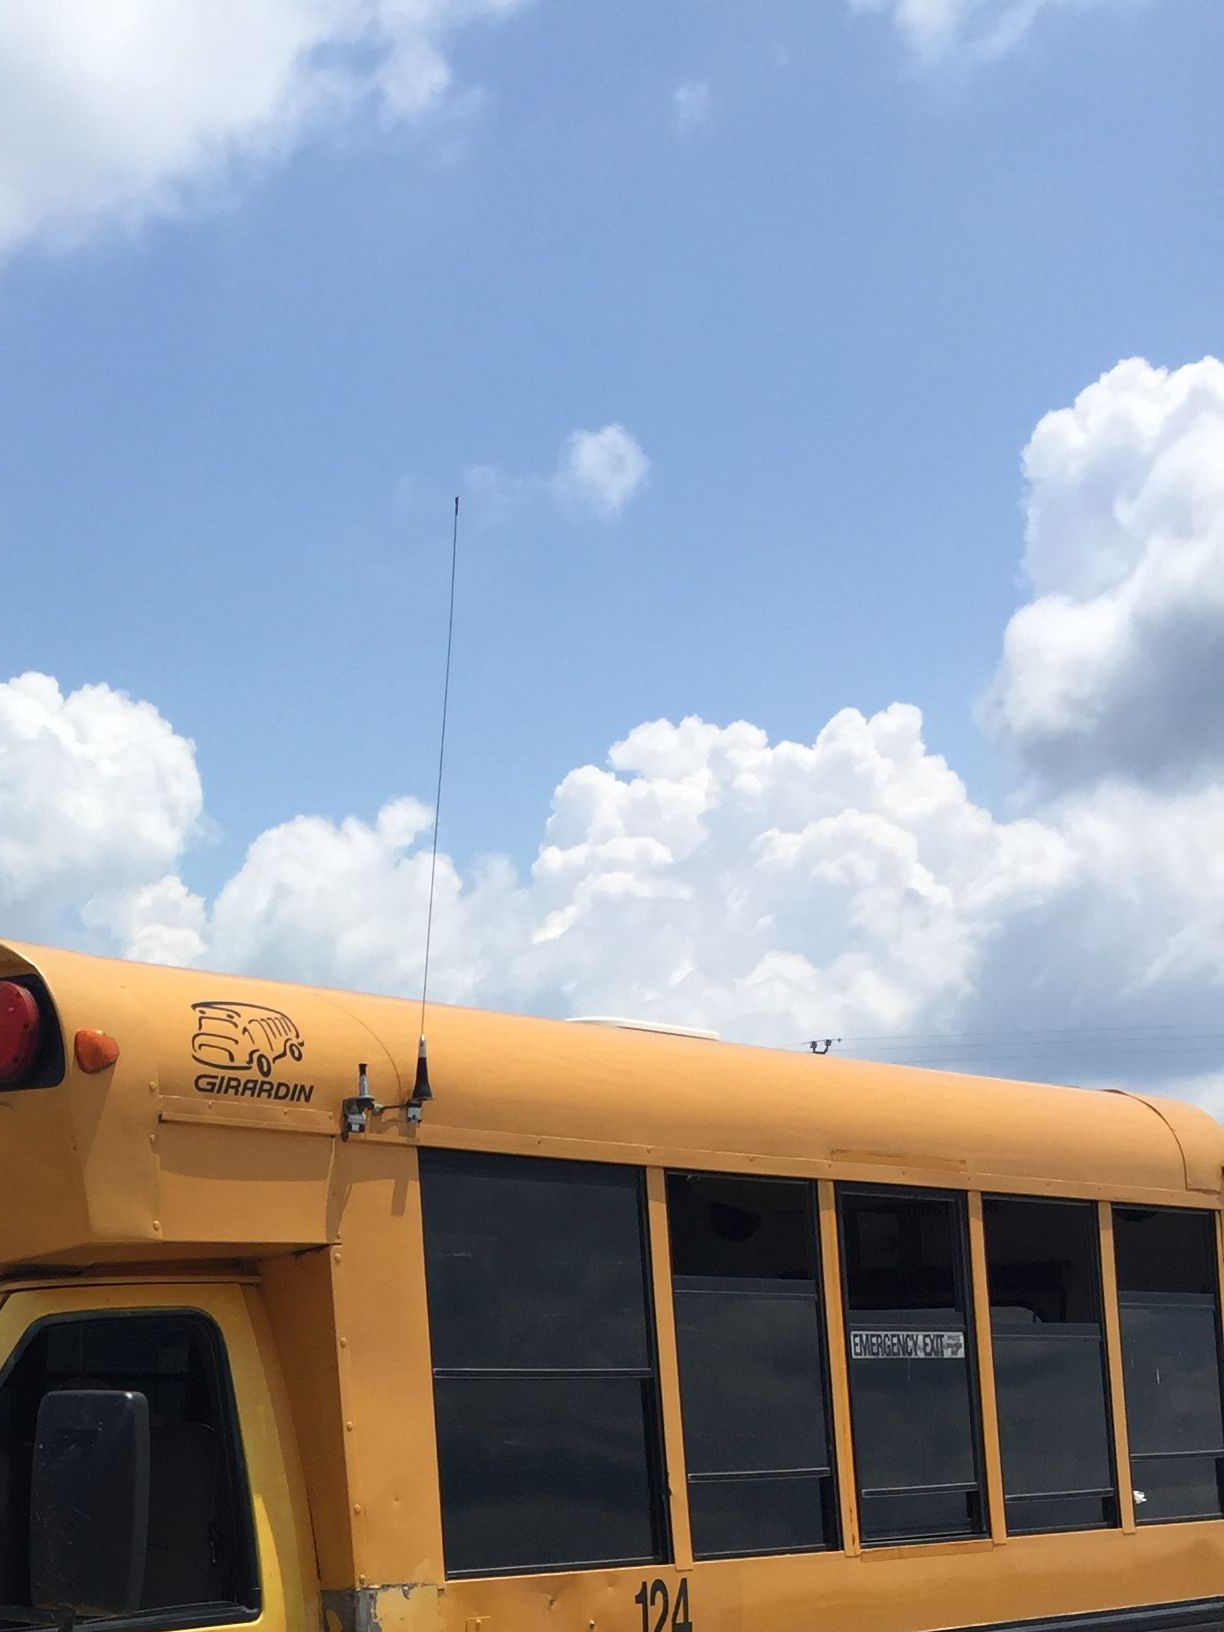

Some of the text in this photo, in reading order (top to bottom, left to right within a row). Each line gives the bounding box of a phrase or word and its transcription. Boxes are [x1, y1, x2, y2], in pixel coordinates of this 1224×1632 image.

[194, 1073, 315, 1103] GIRARDIN
[852, 1333, 919, 1357] EMERGENCY
[923, 1333, 945, 1357] EXIT
